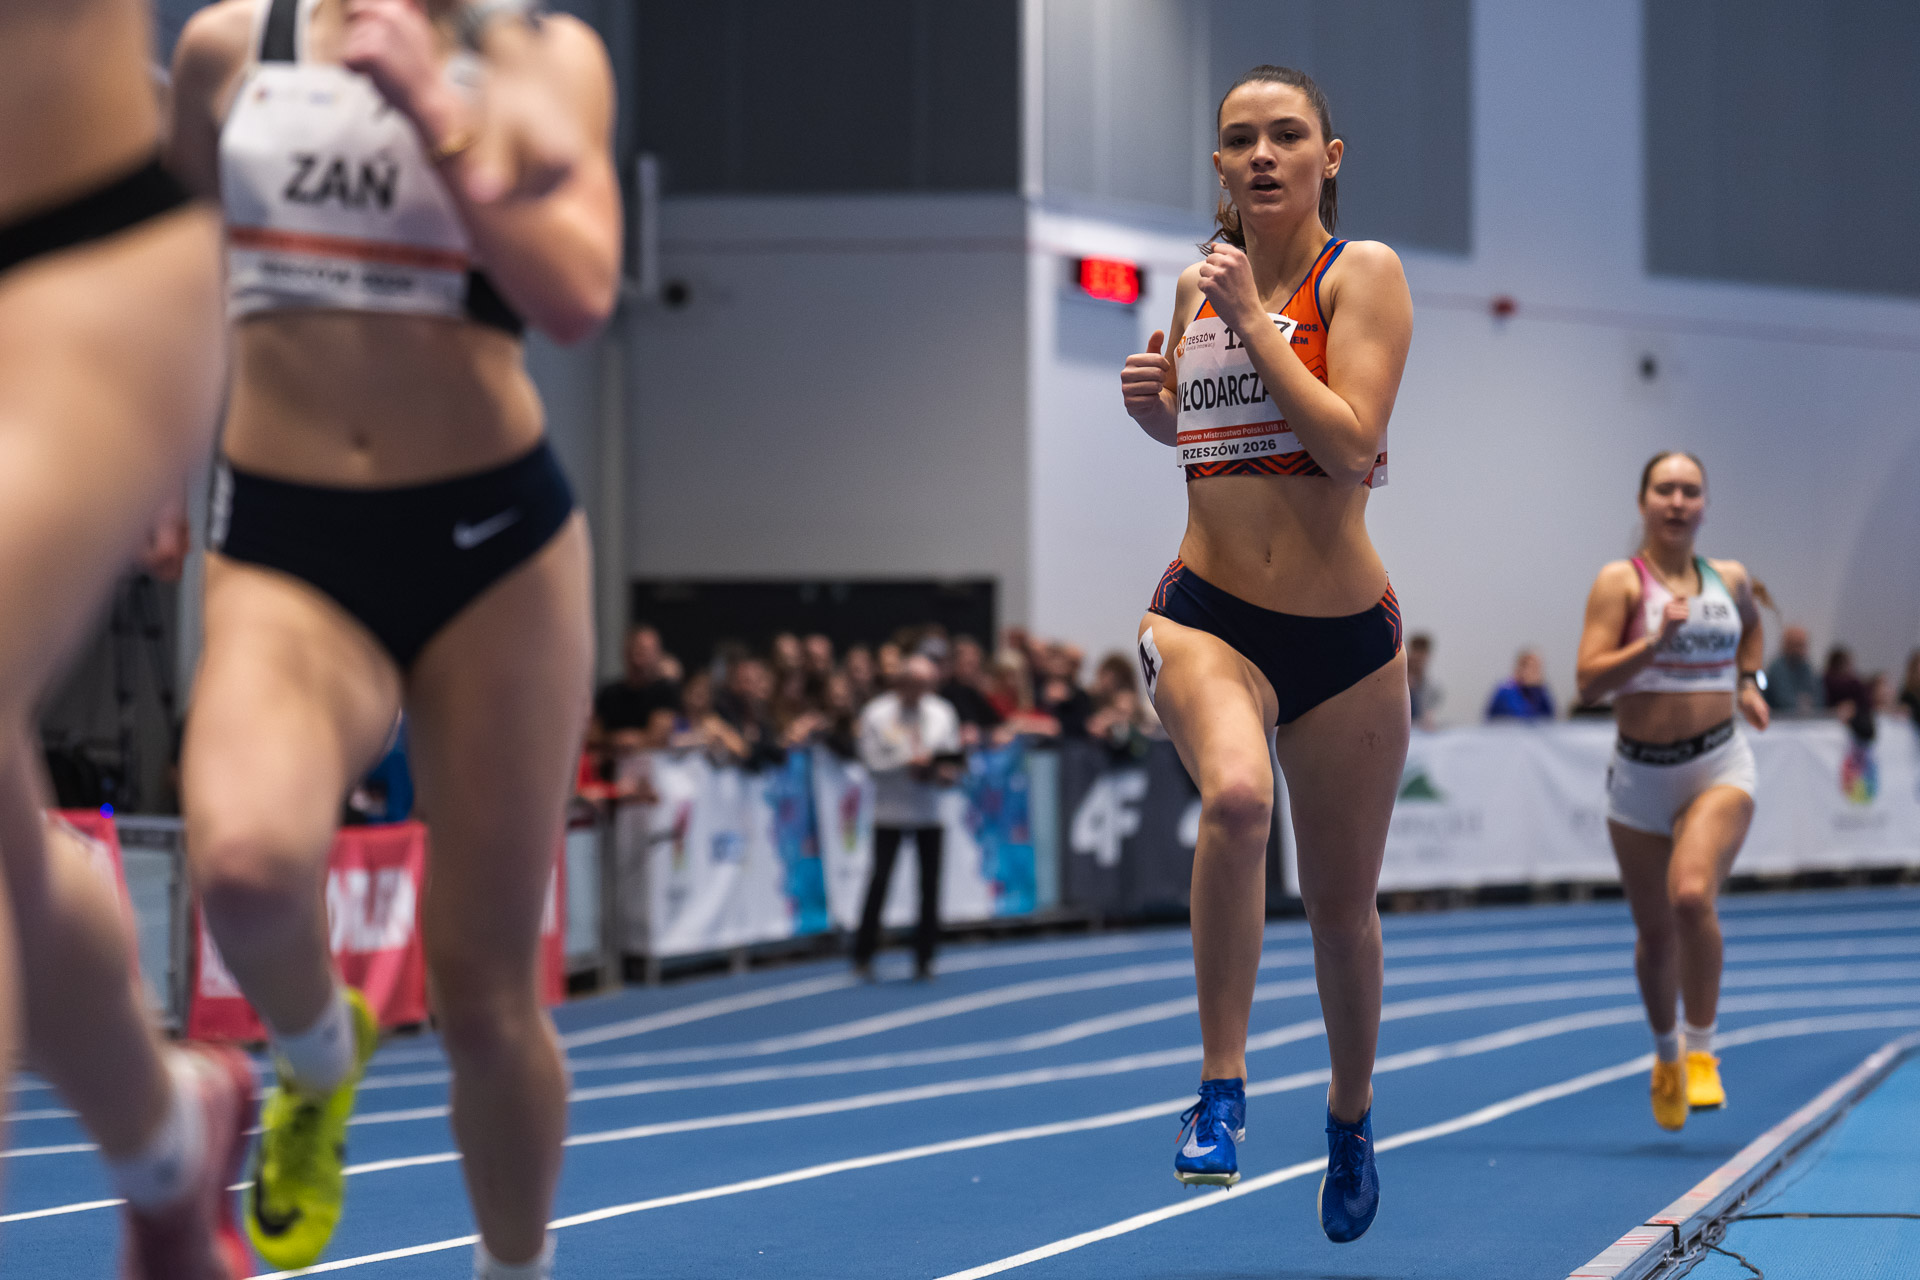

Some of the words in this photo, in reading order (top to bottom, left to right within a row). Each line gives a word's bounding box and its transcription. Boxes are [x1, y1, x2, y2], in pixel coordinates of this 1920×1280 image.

[284, 151, 398, 210] ZAŃ
[1186, 332, 1216, 346] rzeszów
[1203, 428, 1241, 440] Mistrzostwa
[1242, 425, 1264, 435] Polski
[1265, 423, 1279, 432] U18
[1182, 442, 1239, 460] RZESZÓW
[1242, 438, 1277, 453] 2026
[1140, 641, 1157, 688] 4
